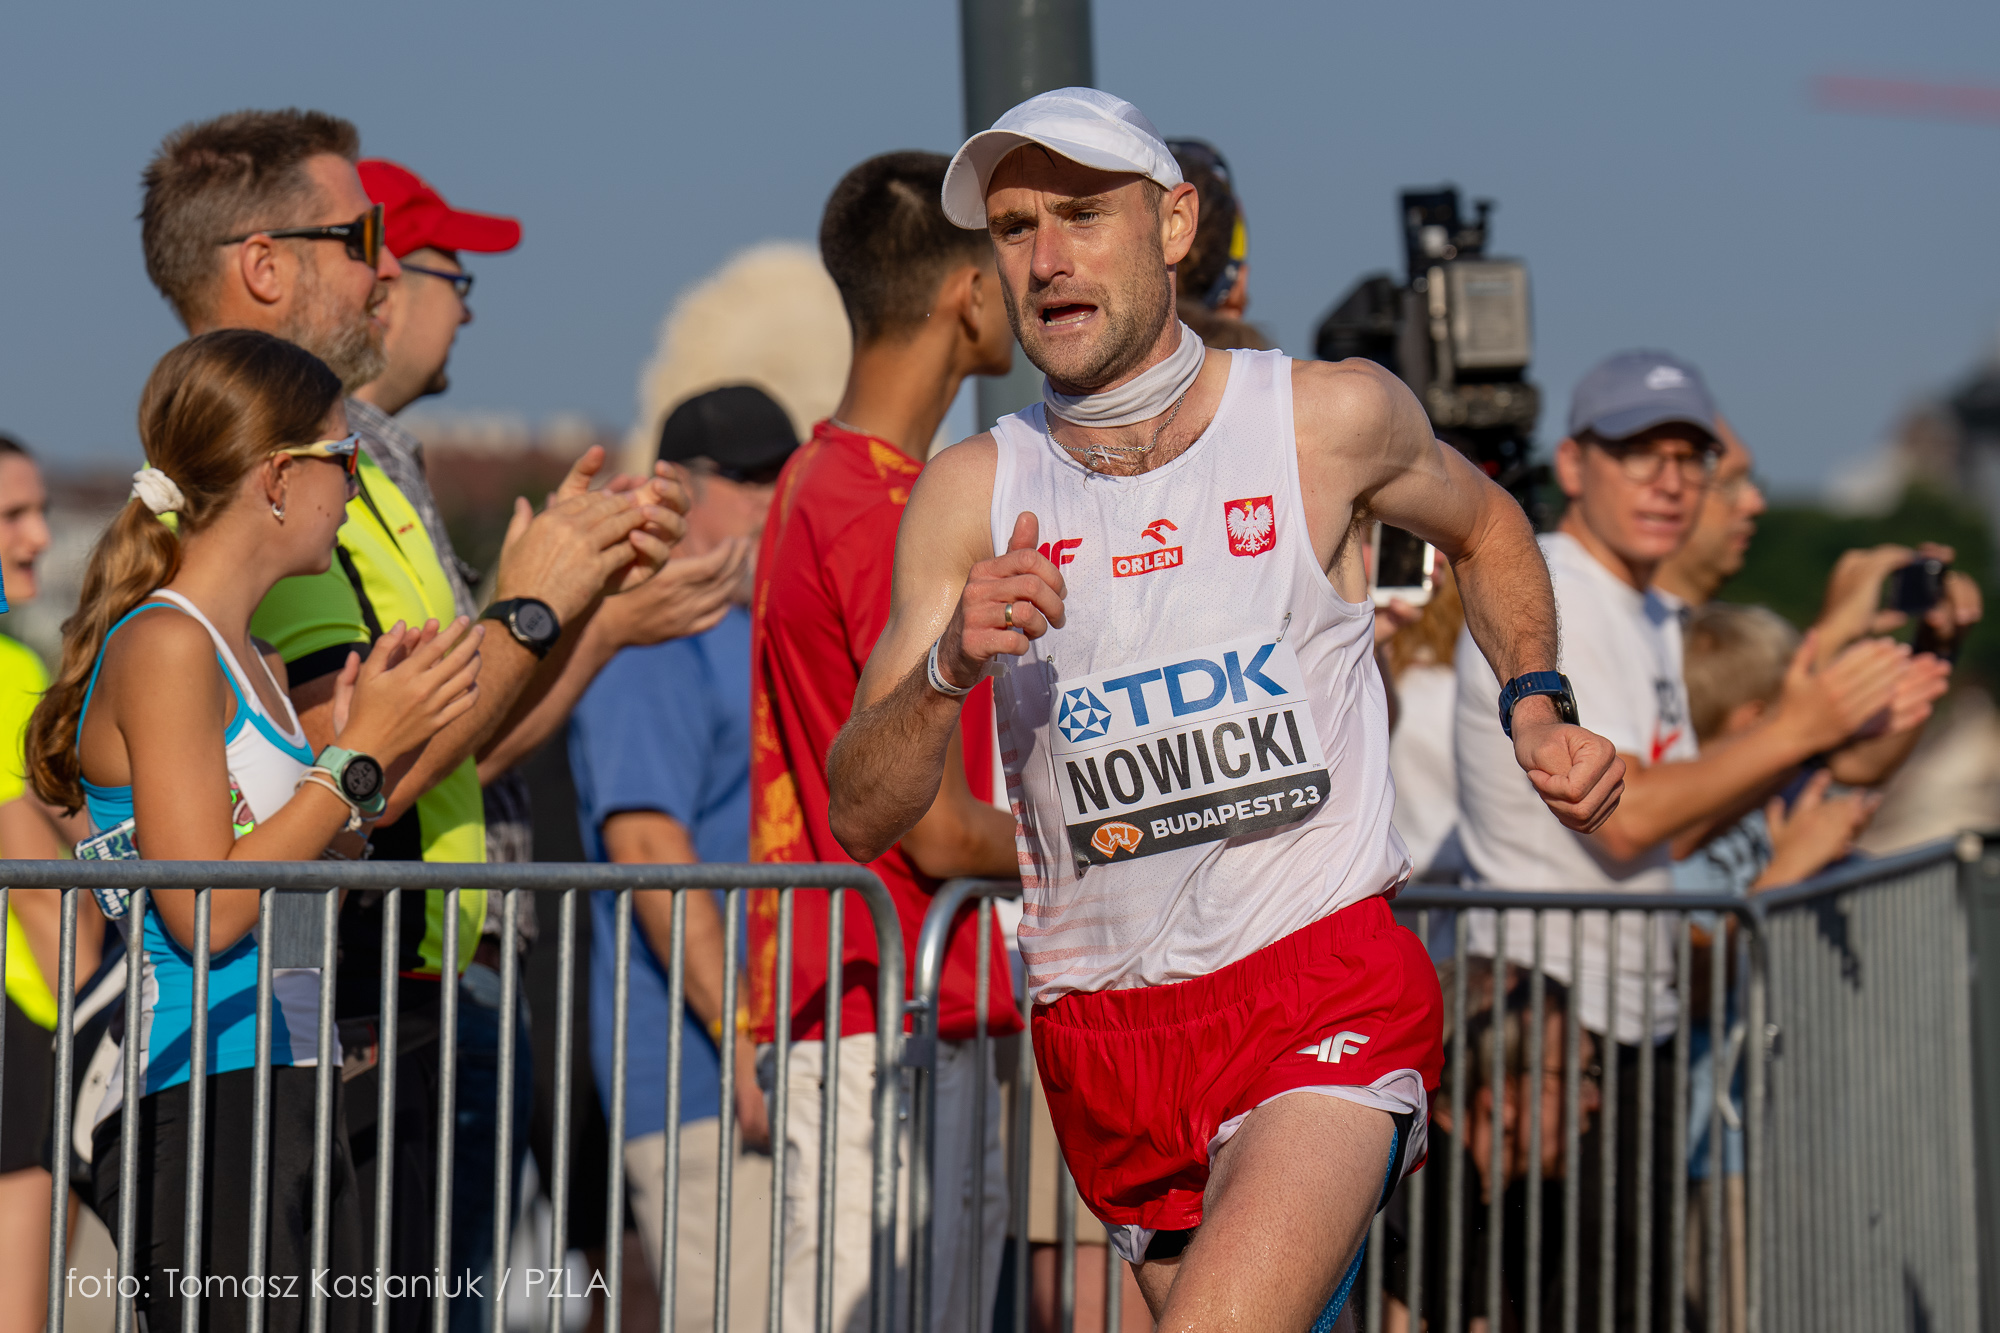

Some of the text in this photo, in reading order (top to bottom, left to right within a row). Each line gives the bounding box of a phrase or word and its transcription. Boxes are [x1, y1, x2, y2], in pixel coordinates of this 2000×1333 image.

[1116, 549, 1179, 575] ORLEN
[1101, 642, 1290, 728] TDK
[1065, 709, 1308, 815] NOWICKI
[1149, 784, 1321, 840] BUDAPEST 23
